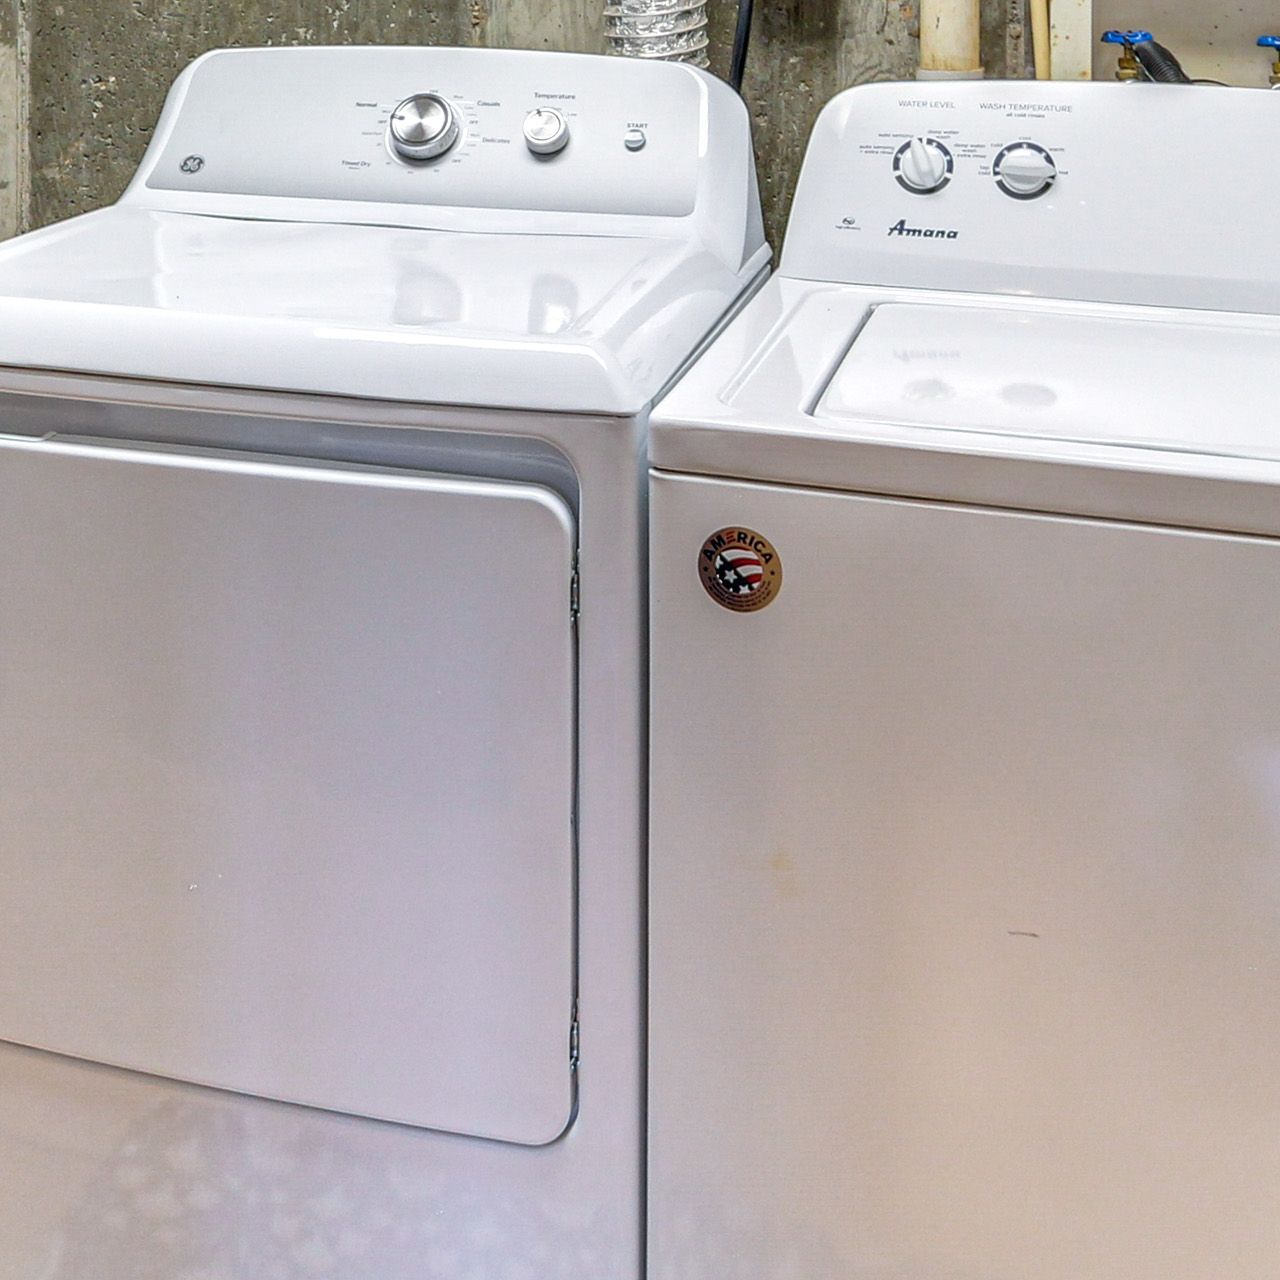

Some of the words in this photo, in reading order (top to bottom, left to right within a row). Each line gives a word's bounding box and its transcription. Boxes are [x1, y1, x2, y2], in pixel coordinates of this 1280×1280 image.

[534, 91, 576, 100] Temperature
[898, 99, 928, 109] WATER
[930, 100, 956, 109] LEVEL
[1008, 103, 1073, 113] TEMPERATURE
[887, 219, 959, 239] Amana
[703, 531, 773, 564] AMERICA
